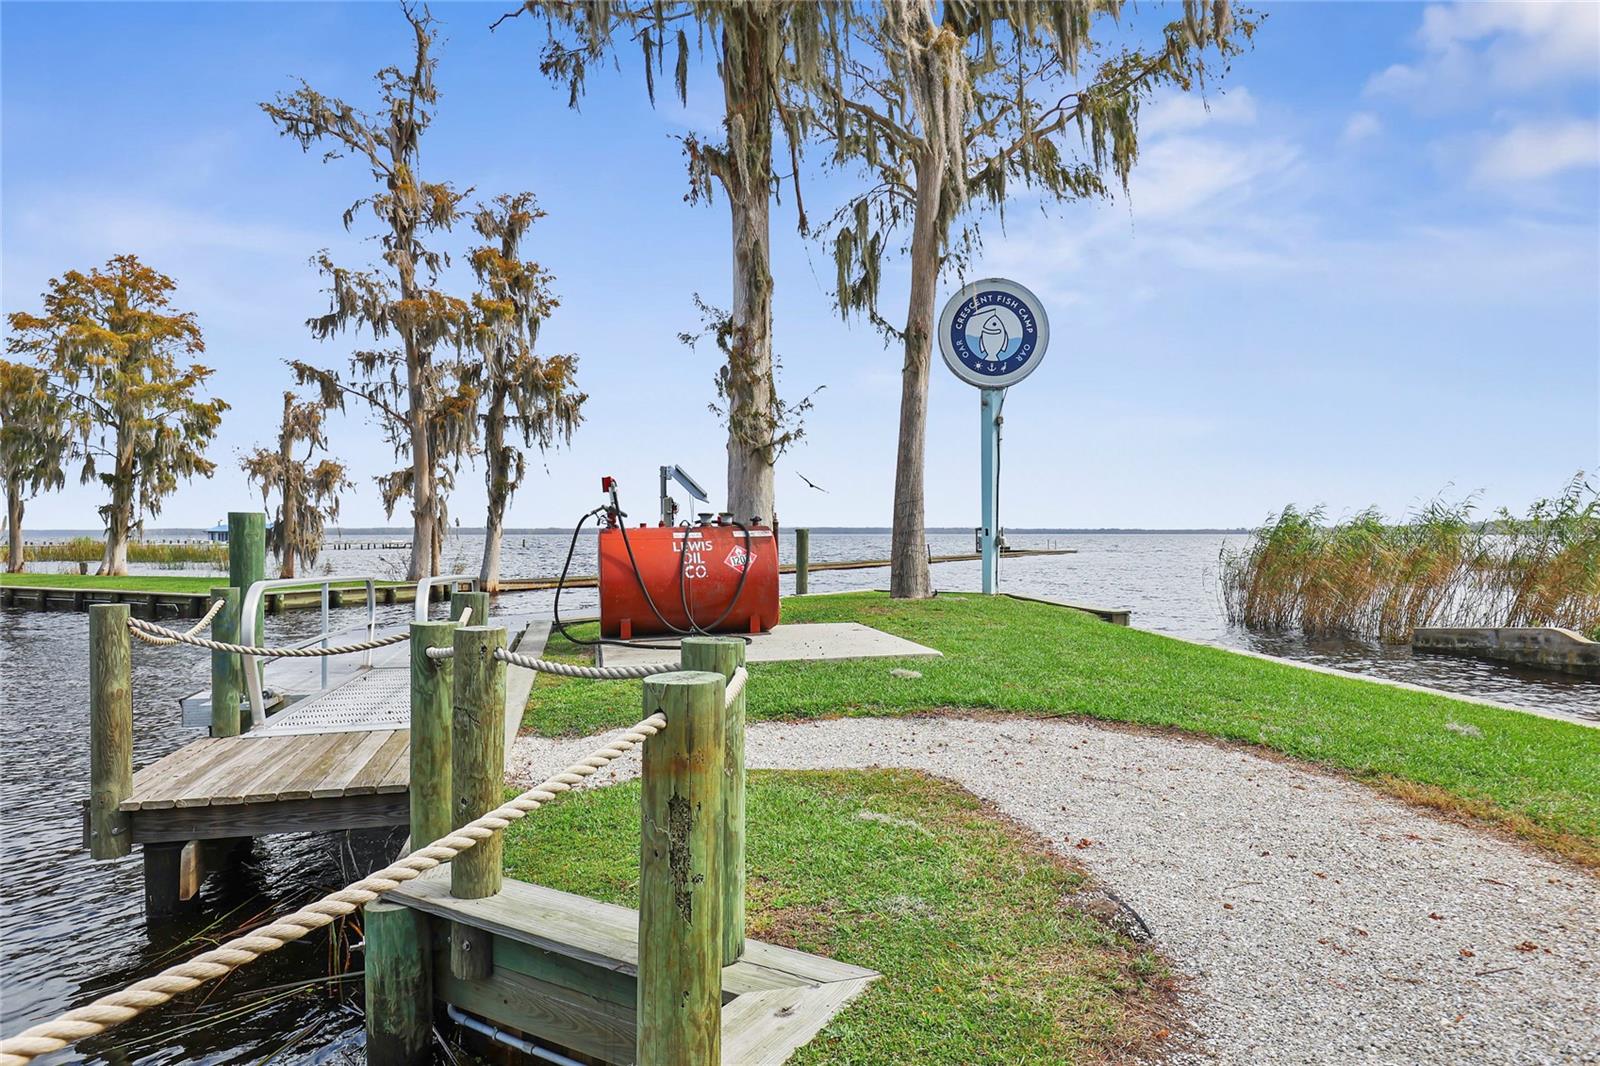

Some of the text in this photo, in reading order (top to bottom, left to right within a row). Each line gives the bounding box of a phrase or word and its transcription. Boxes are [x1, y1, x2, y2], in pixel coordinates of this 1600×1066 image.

[955, 295, 1033, 333] CRESCENT FISH CAMP
[956, 339, 969, 358] OAR
[1015, 343, 1031, 362] OAR
